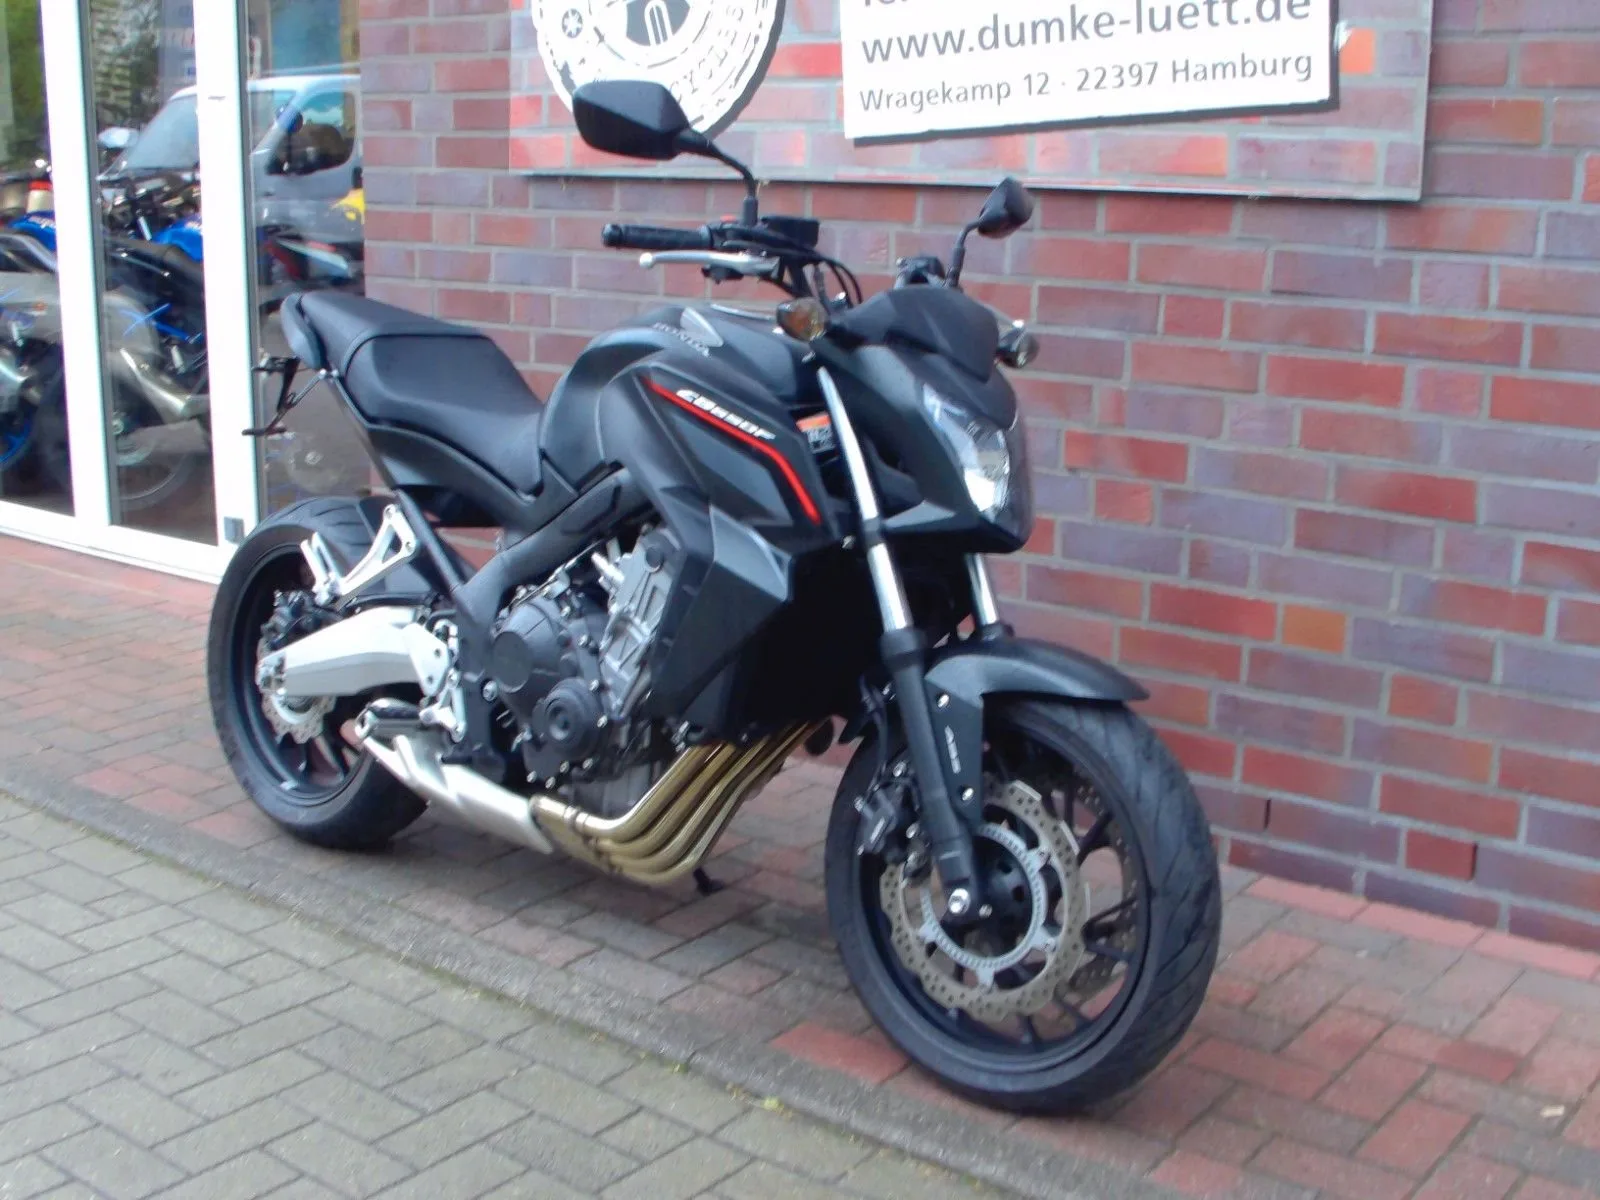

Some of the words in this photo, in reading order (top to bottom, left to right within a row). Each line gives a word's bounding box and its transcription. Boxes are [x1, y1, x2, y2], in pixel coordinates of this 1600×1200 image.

[862, 0, 1311, 63] www.dumke-luett.de
[860, 81, 1011, 114] Wragekamp
[1023, 72, 1050, 97] 12
[1076, 61, 1159, 92] 22397
[1171, 52, 1312, 83] Hamburg
